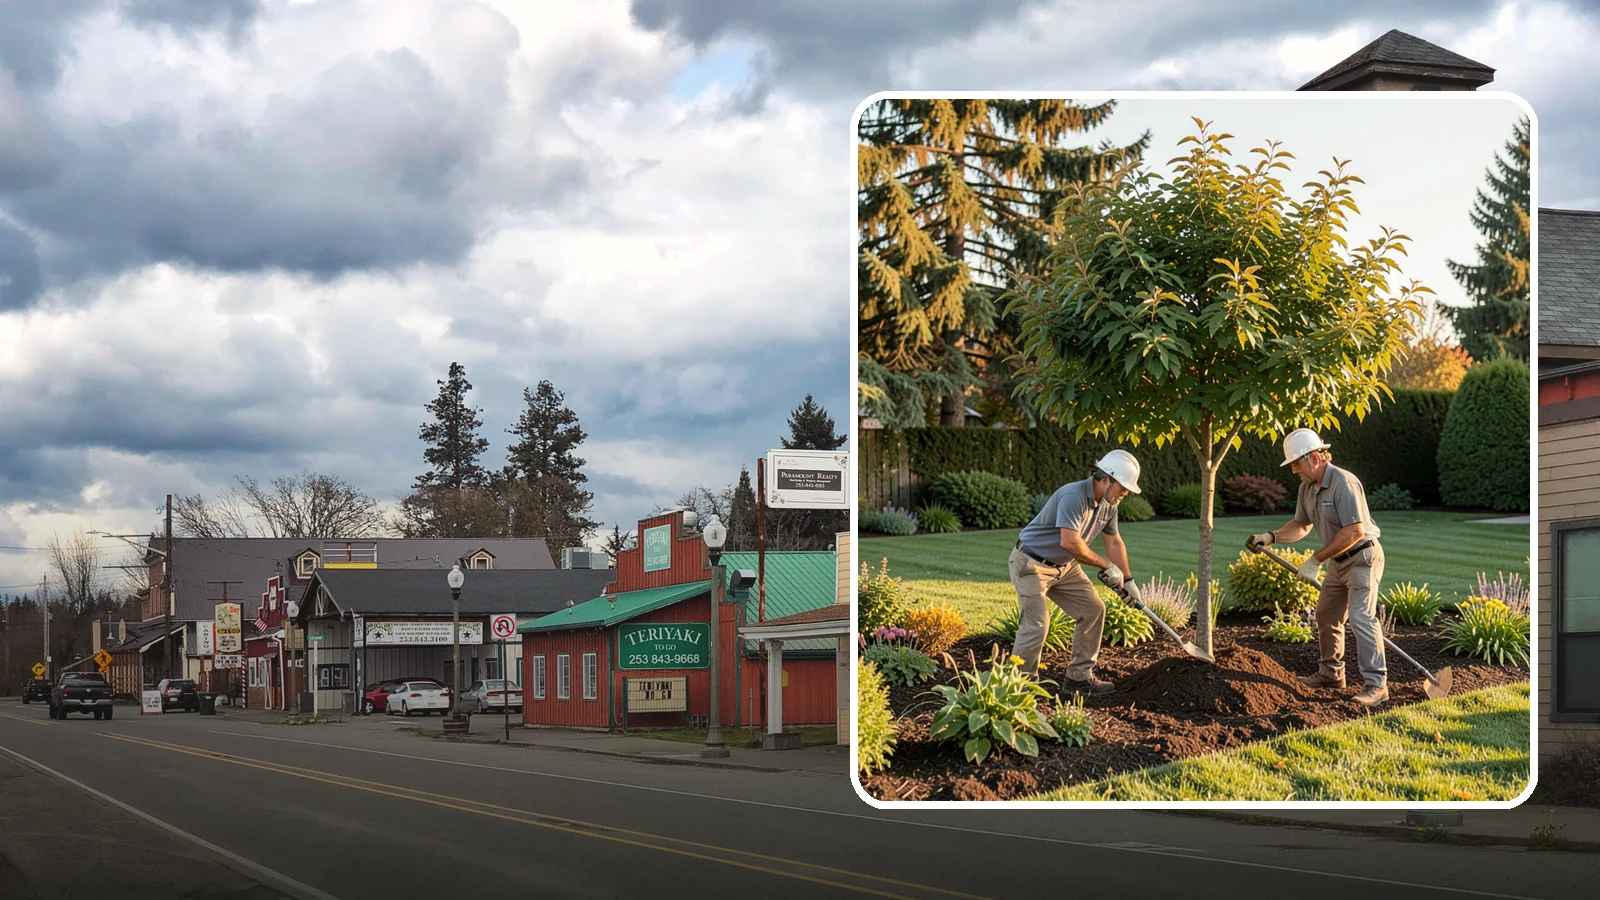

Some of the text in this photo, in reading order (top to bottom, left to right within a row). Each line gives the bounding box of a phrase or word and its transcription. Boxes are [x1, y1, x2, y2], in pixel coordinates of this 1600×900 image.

[781, 471, 815, 479] PARAMOUNT
[625, 627, 702, 646] TERIYAKI
[629, 654, 700, 664] 253 843-9668
